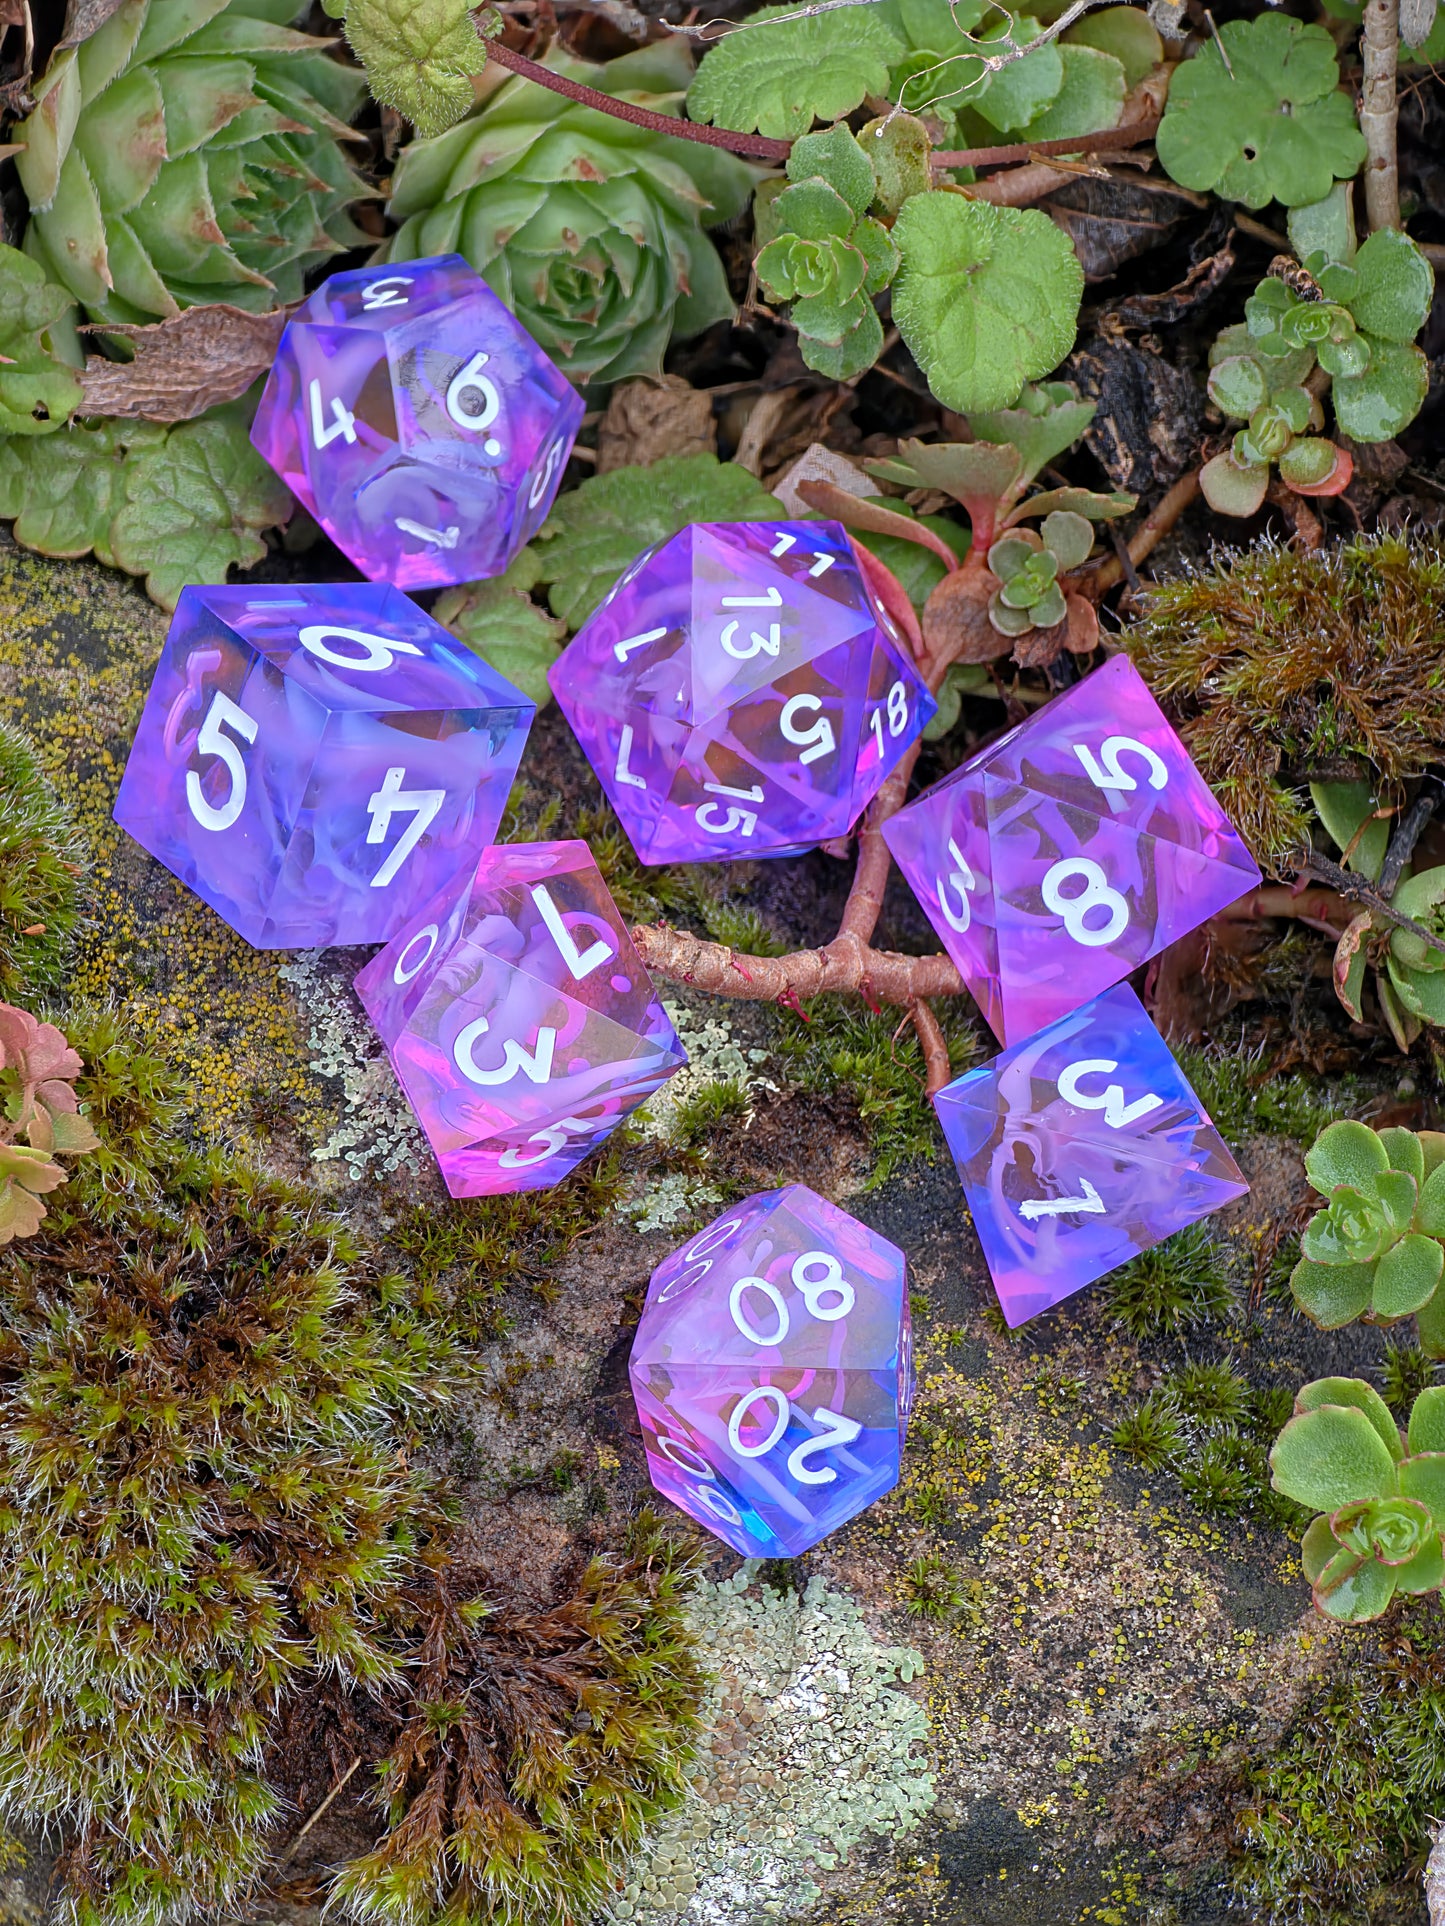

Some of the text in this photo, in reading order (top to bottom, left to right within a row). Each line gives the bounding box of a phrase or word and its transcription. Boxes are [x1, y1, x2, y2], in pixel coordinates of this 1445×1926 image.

[361, 276, 415, 311] 3
[309, 378, 356, 450] 4
[395, 517, 460, 549] 1
[769, 532, 835, 578] 11
[298, 625, 425, 671] 6
[613, 627, 668, 662] 1
[720, 587, 783, 659] 13
[779, 693, 836, 765] 5
[870, 680, 909, 759] 18
[186, 690, 259, 831] 5
[614, 724, 647, 789] 7
[1072, 736, 1168, 791] 5
[366, 767, 446, 887] 4
[695, 782, 765, 837] 15
[530, 883, 614, 980] 7
[1041, 857, 1129, 946] 8
[394, 923, 439, 985] 0
[453, 1016, 557, 1085] 3
[1057, 1059, 1163, 1129] 3
[498, 1117, 596, 1168] 5
[1018, 1176, 1107, 1221] 1
[728, 1251, 856, 1347] 80
[727, 1385, 864, 1485] 20
